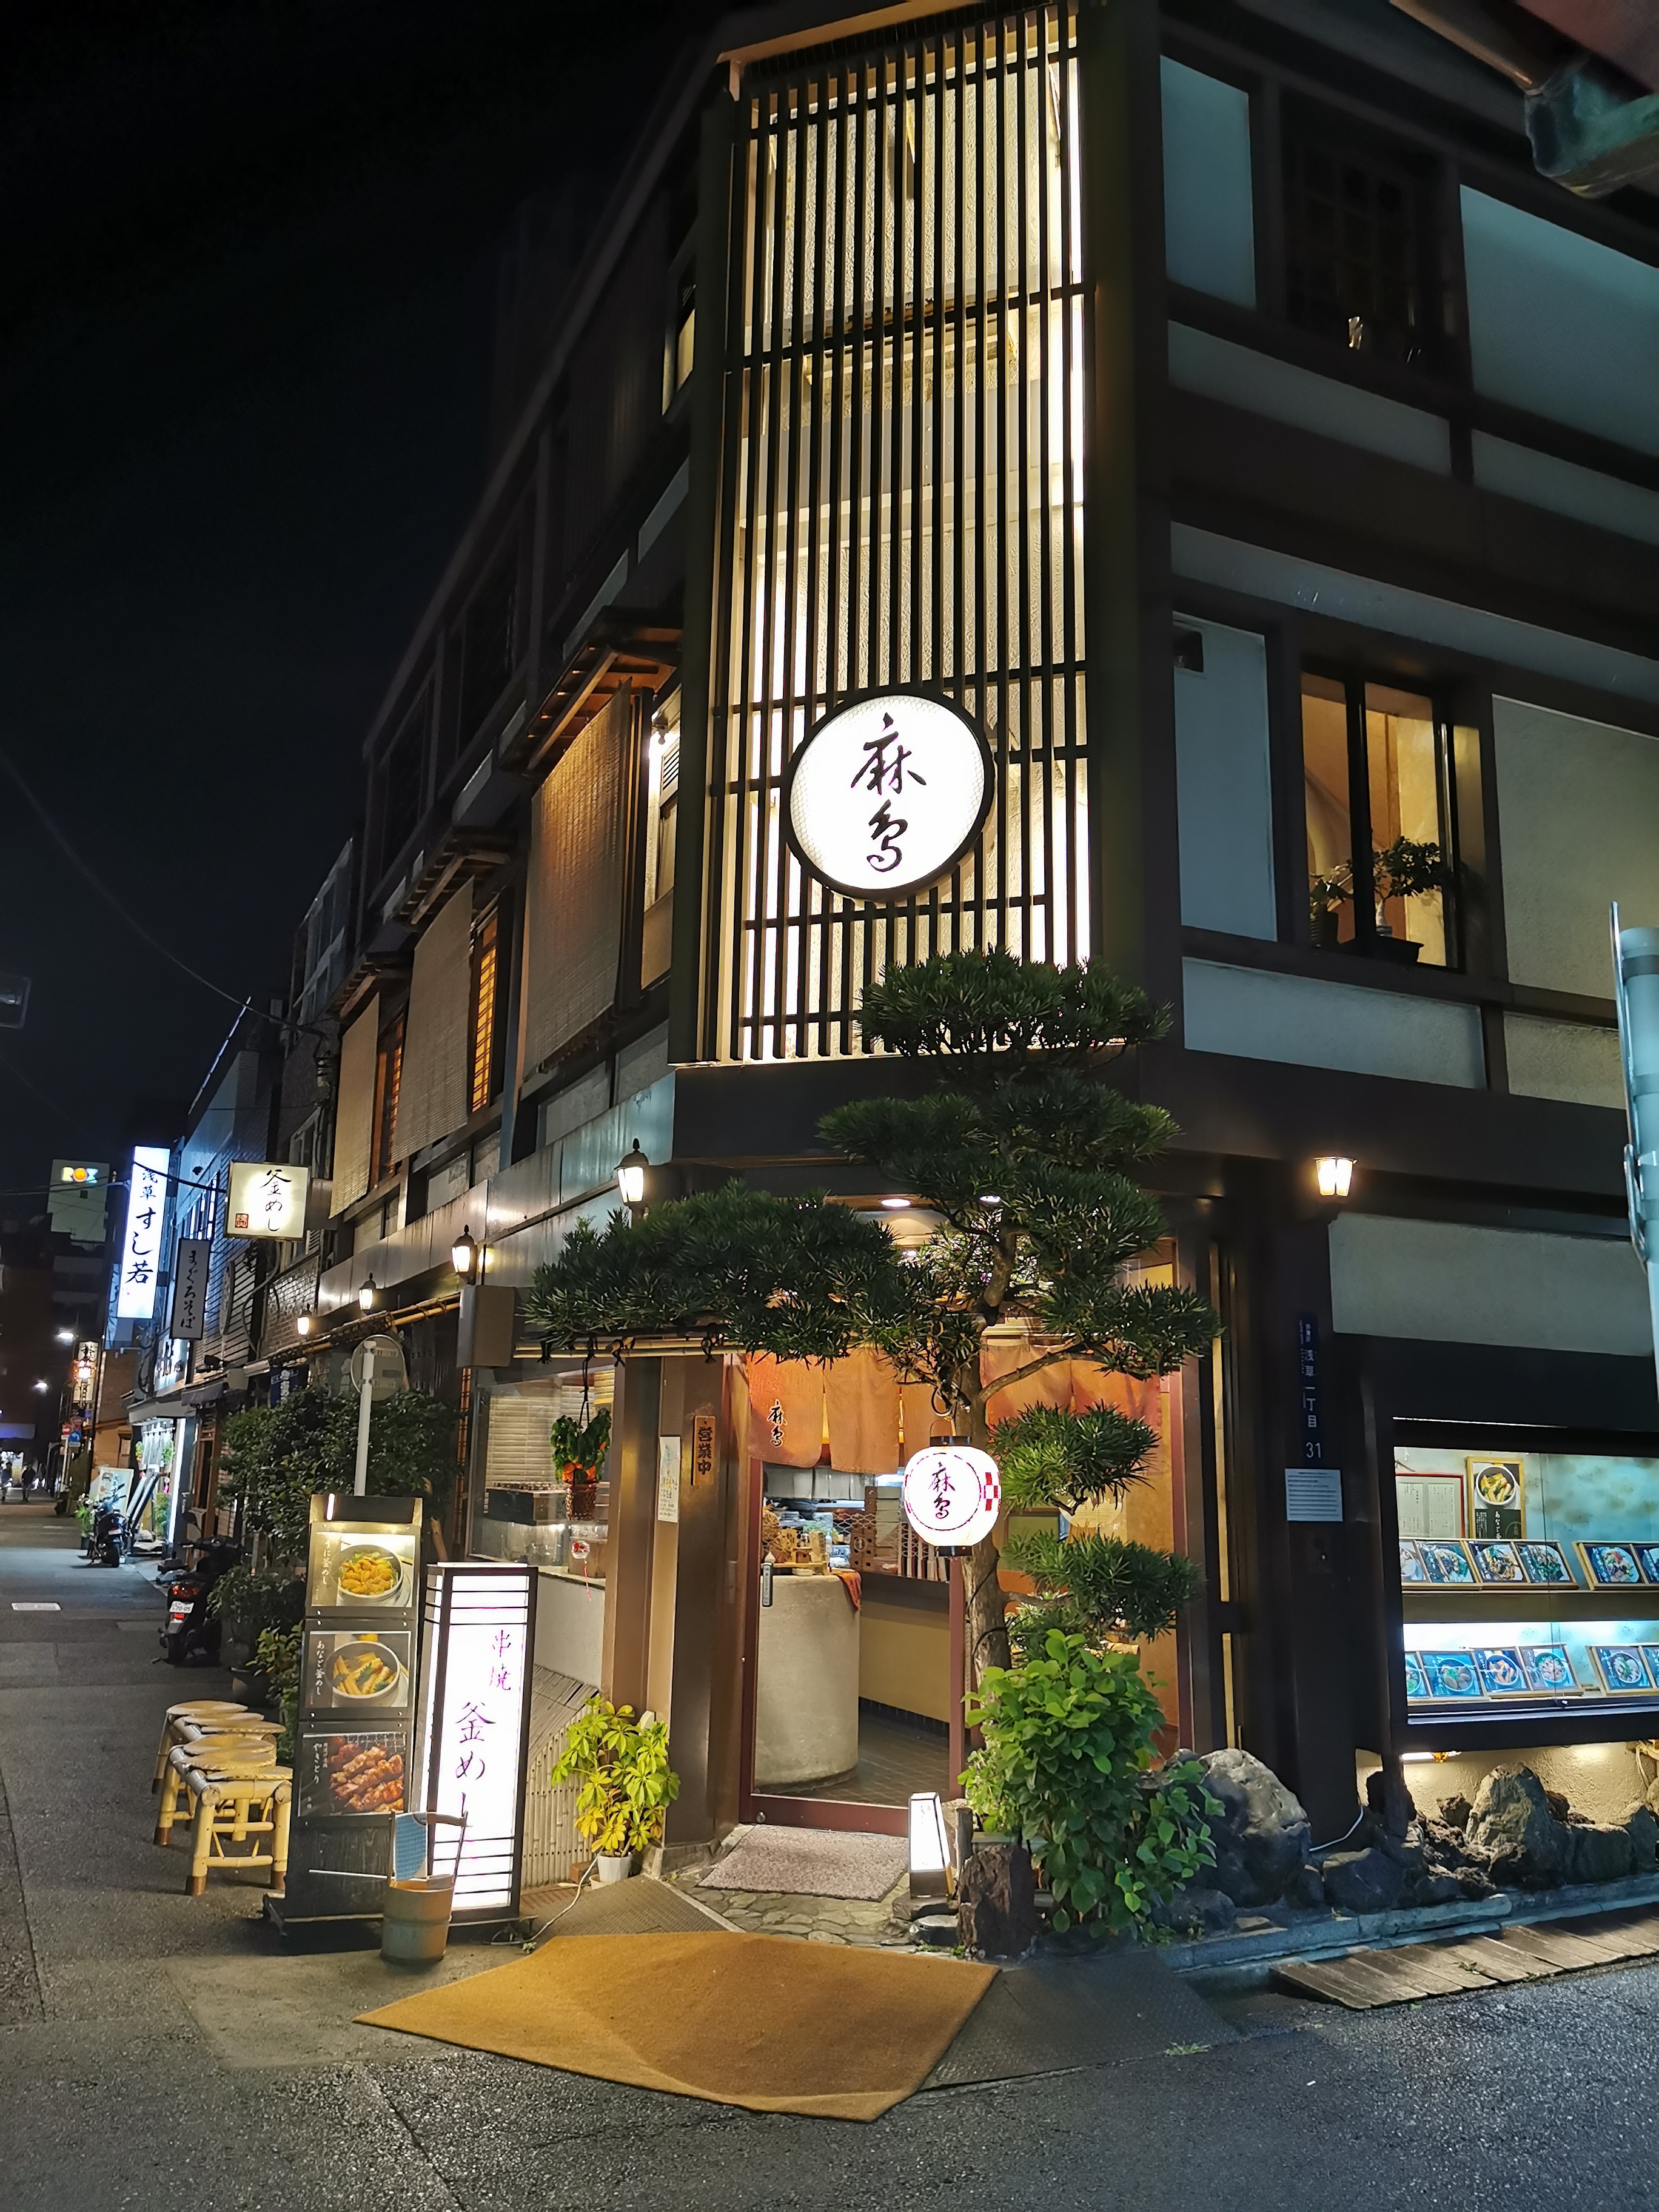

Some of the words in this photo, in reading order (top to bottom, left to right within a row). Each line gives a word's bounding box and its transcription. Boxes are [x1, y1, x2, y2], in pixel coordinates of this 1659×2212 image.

[61, 1167, 99, 1184] ROX
[258, 1169, 292, 1232] 釜めし
[697, 1426, 713, 1475] 営業中
[1305, 1442, 1322, 1458] 31
[489, 1629, 511, 1691] 串焼
